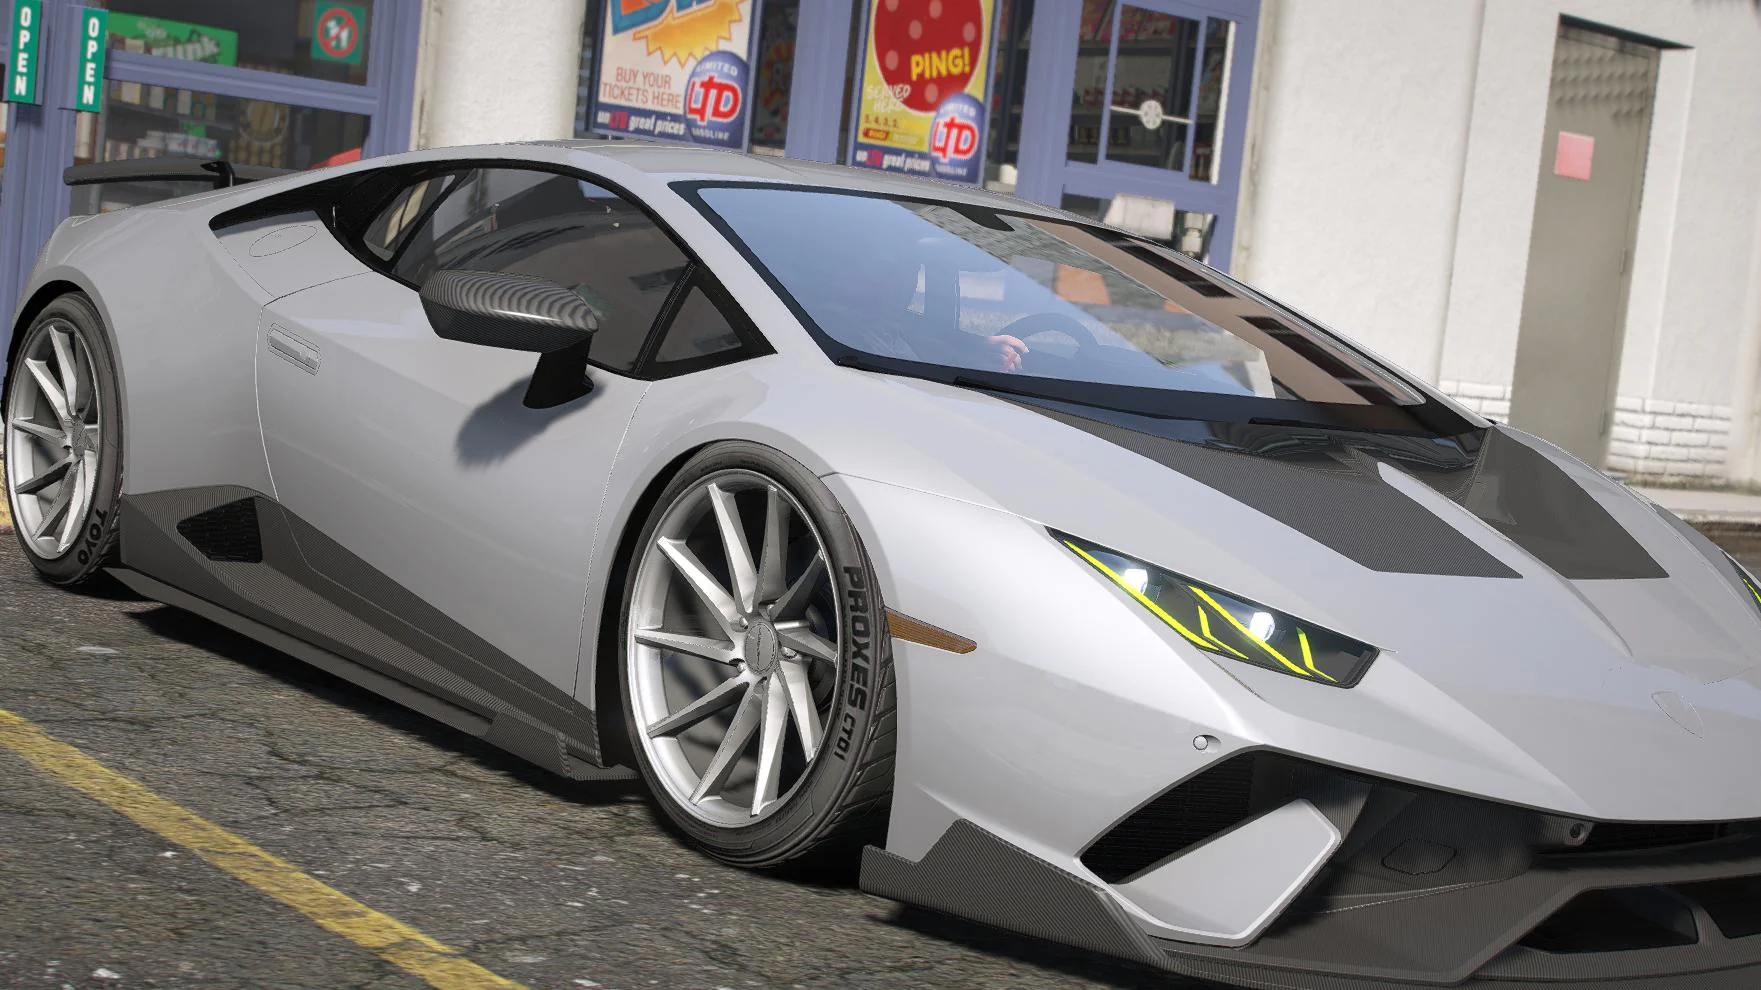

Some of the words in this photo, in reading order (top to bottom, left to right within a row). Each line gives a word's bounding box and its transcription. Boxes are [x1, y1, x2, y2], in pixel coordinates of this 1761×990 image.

[14, 6, 32, 96] OPEN
[82, 16, 100, 105] OPEN
[910, 46, 971, 82] PING!
[601, 81, 649, 105] TICKETS
[652, 90, 682, 109] HERE
[615, 66, 639, 84] BUY
[642, 71, 672, 90] YOUR
[687, 72, 742, 123] LTD
[930, 116, 978, 160] LTD
[77, 507, 109, 566] TOYO
[843, 565, 871, 712] PROXES
